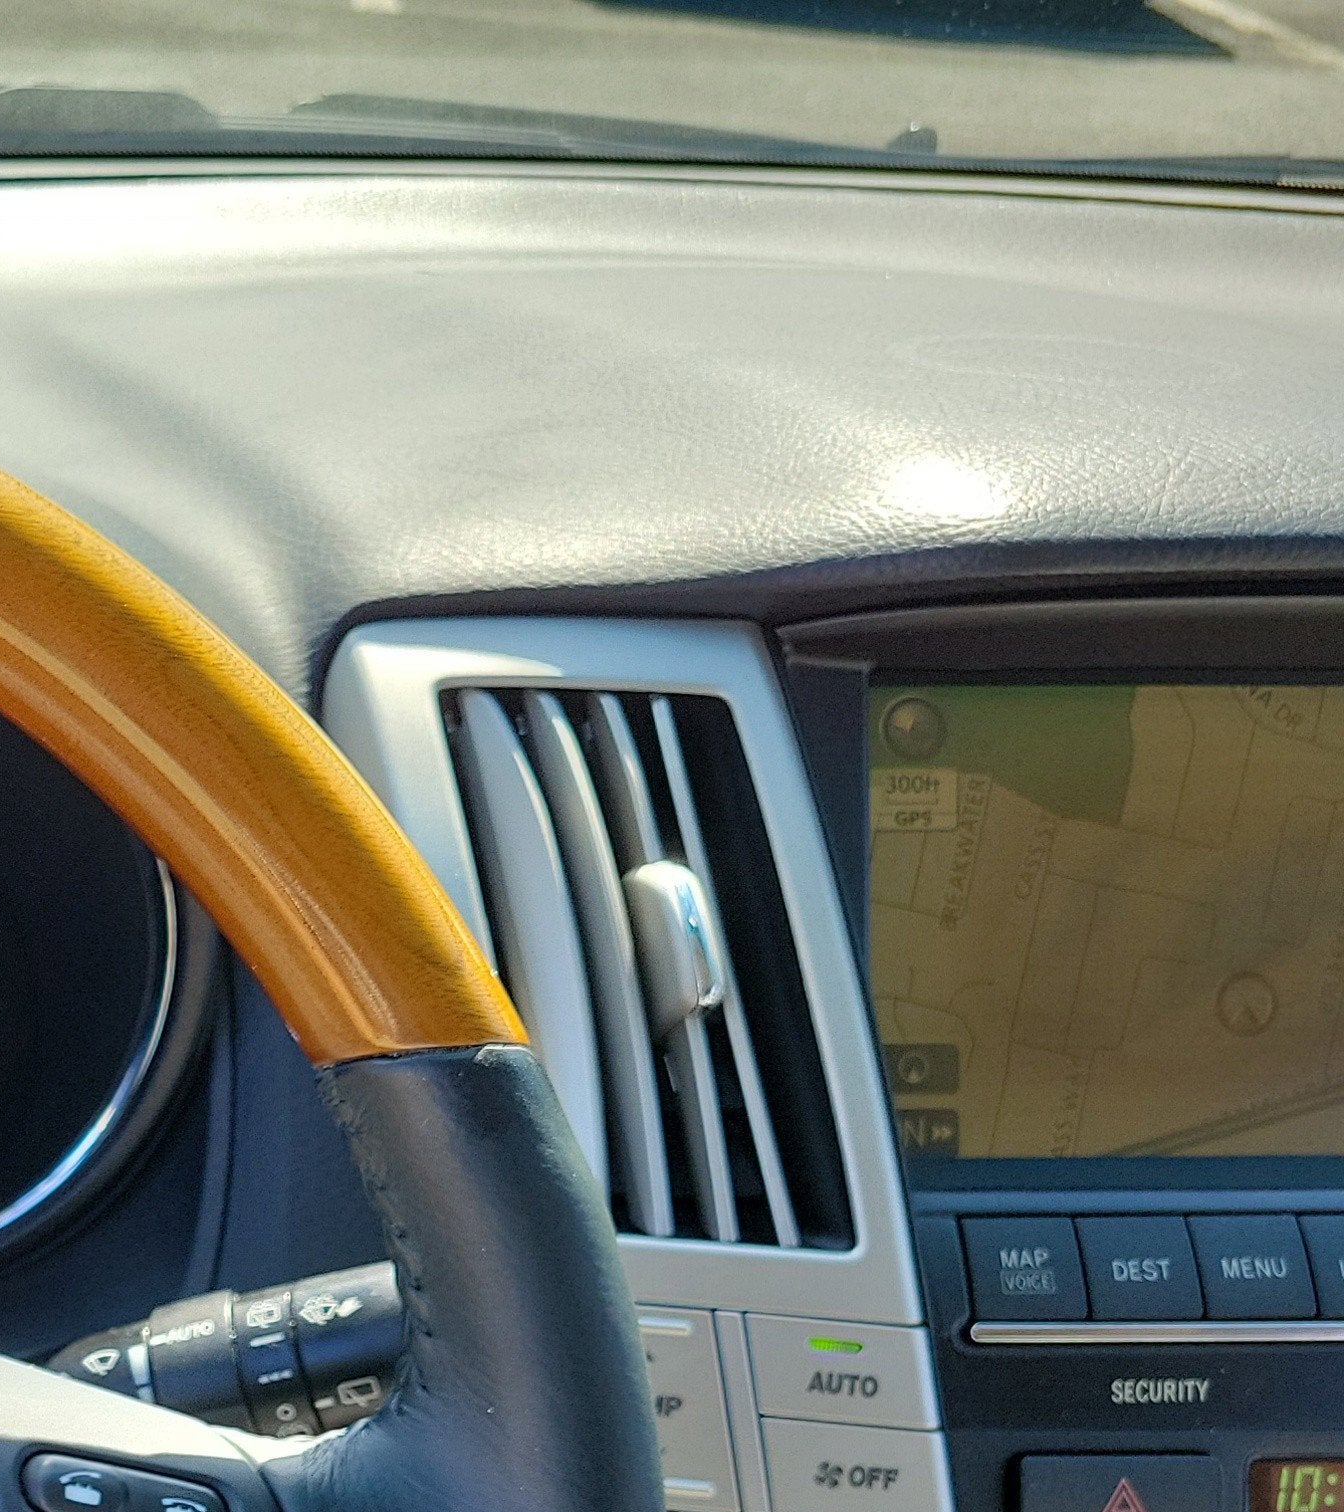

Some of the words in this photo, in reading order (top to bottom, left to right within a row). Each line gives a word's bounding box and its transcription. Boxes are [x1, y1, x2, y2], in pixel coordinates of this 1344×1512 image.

[886, 774, 941, 795] 300ft
[895, 811, 932, 826] GPS
[999, 1248, 1050, 1269] MAP
[1111, 1257, 1171, 1283] DEST
[1220, 1256, 1289, 1280] MENU
[1002, 1271, 1053, 1292] VOICE
[167, 1318, 216, 1345] AUTO
[808, 1371, 879, 1399] AUTO
[1111, 1376, 1211, 1405] SECURITY
[849, 1465, 900, 1490] OFF
